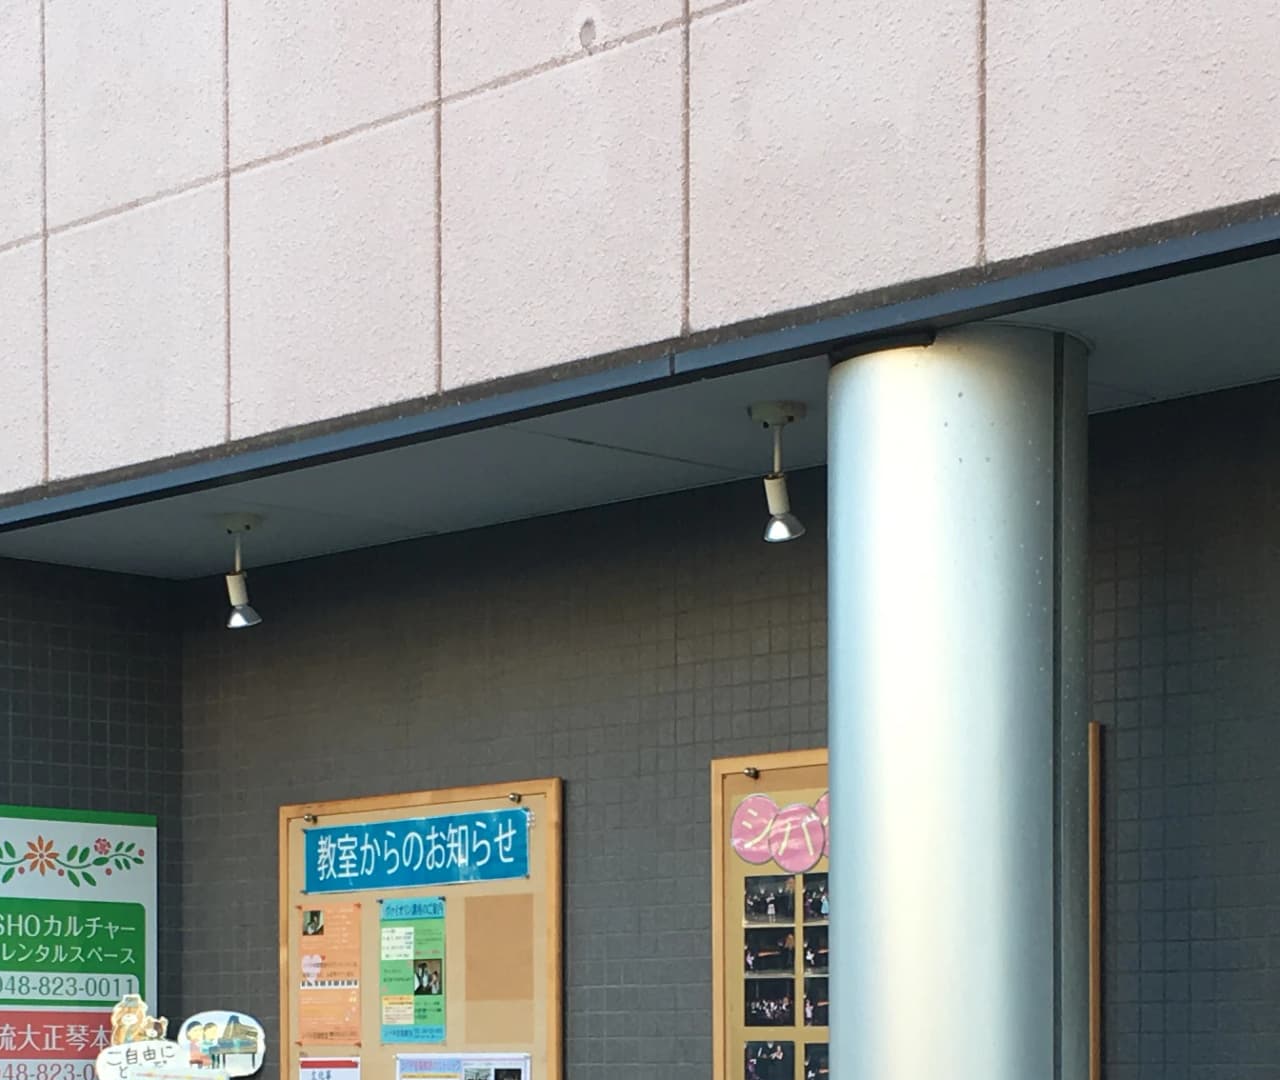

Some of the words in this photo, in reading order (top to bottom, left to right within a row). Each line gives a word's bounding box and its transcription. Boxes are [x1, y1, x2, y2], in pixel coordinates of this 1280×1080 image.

[317, 819, 517, 881] 教室からのお知らせ
[742, 806, 829, 857] シバ
